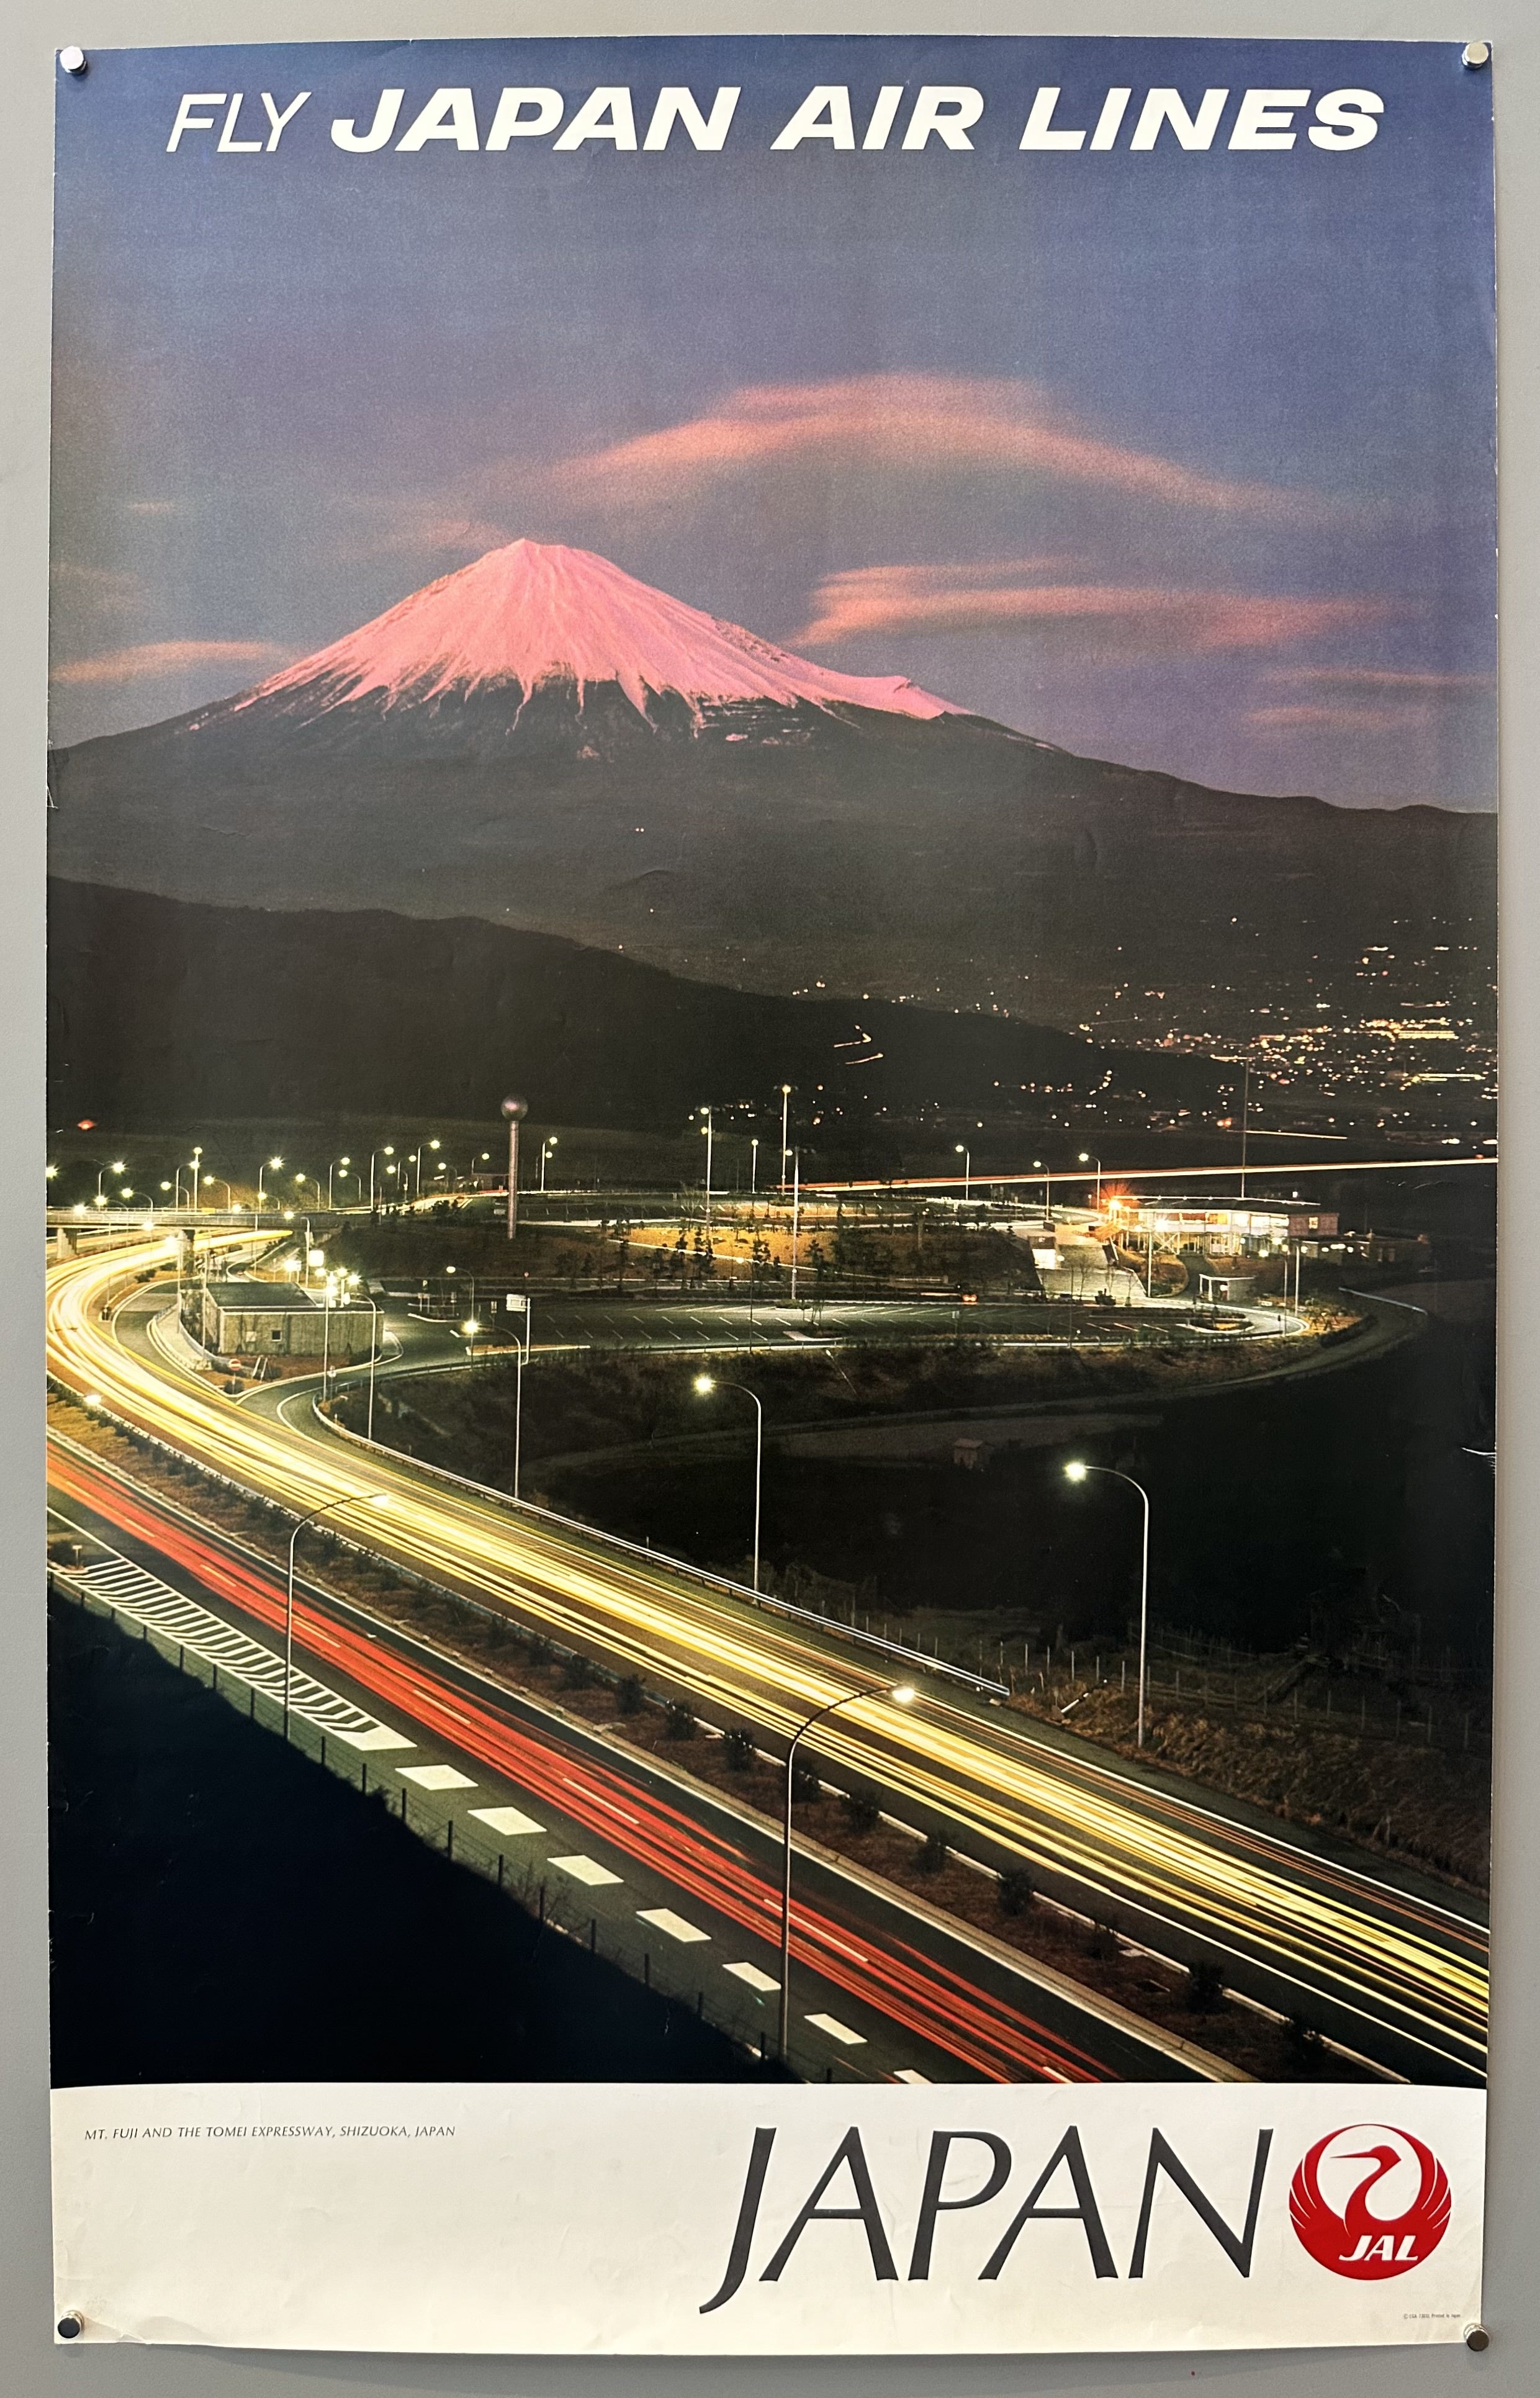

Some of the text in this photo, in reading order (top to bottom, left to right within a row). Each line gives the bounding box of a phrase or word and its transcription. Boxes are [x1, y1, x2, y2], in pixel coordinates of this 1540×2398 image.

[165, 86, 1385, 153] FLY JAPAN AIR LINES
[84, 2125, 456, 2140] MT. FUJI AND THE TOMEI EXPRESSWAY, SHIZUOKA, JAPAN
[699, 2125, 1274, 2314] JAPAN
[1338, 2235, 1418, 2261] JAL
